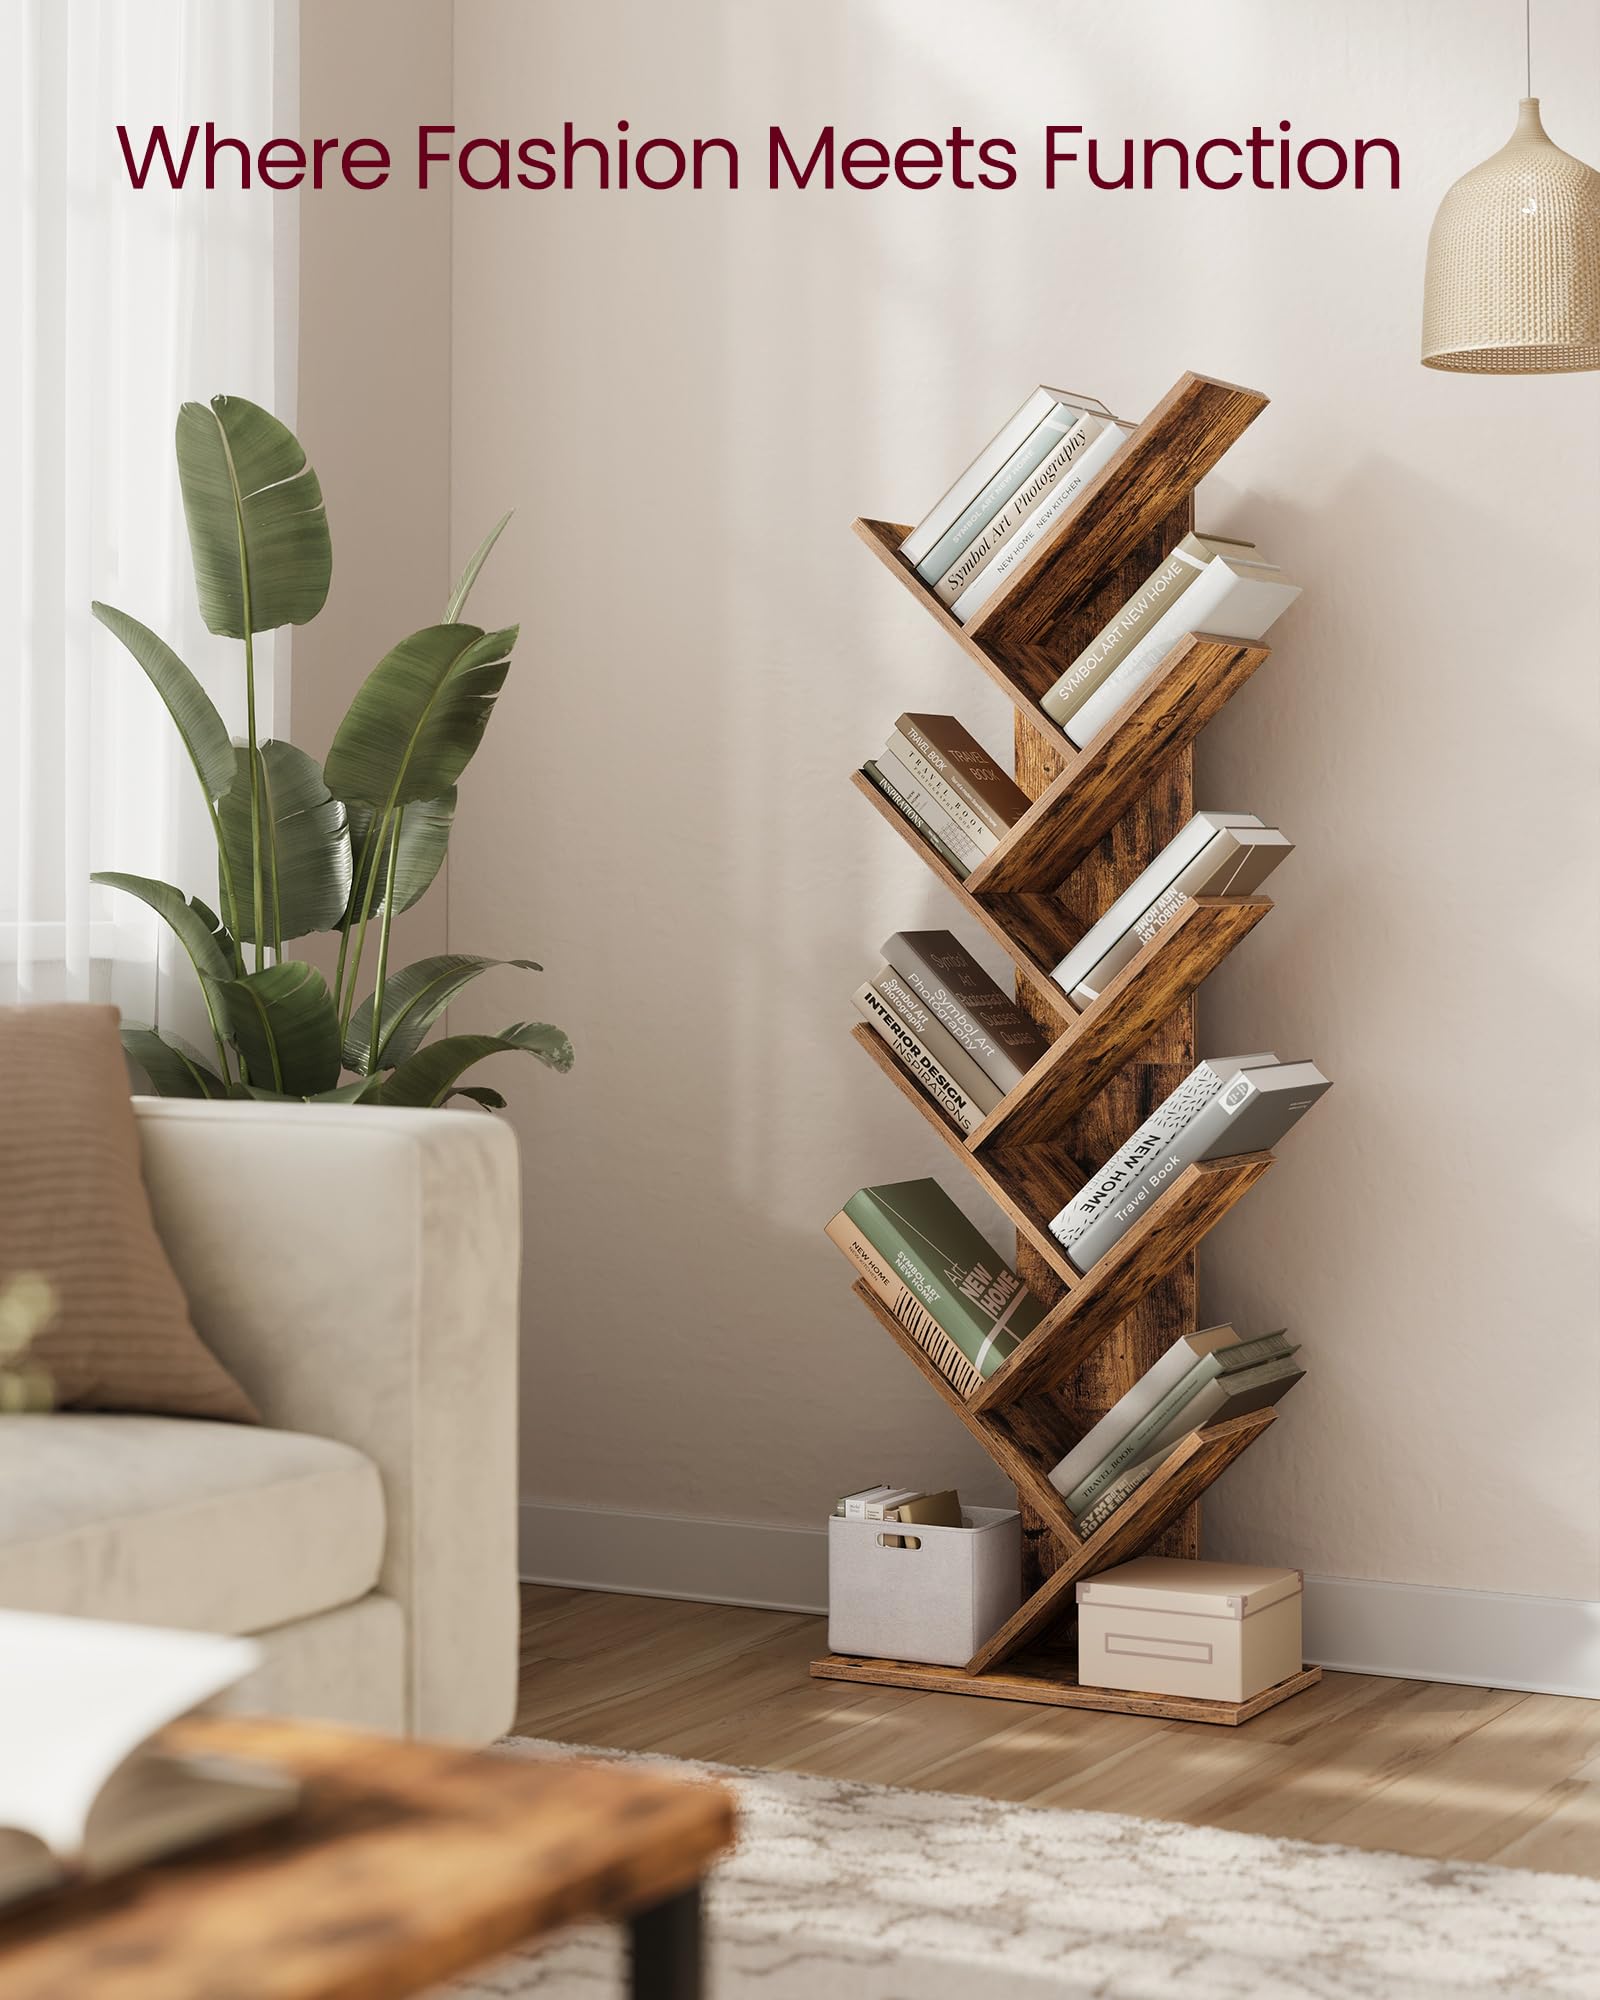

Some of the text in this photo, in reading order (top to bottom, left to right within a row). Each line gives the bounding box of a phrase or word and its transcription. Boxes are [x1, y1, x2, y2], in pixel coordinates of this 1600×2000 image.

[948, 429, 1088, 592] Symbol Art Photography
[952, 509, 983, 545] SYMBOL
[981, 491, 999, 513] ART
[994, 473, 1014, 497] NEW
[997, 476, 1082, 574] NEW HOME NEW KITCHEN
[1058, 653, 1104, 701] SYMBOL
[1101, 627, 1124, 655] ART
[1121, 597, 1150, 631] NEW
[1146, 561, 1183, 603] HOME
[907, 728, 948, 772] TRAVEL BOOK
[878, 778, 925, 829] INSPIRATIONS
[908, 751, 950, 796] TRAVEL
[954, 802, 984, 835] BOOK
[1133, 886, 1179, 936] NEW HOME
[1138, 891, 1188, 946] SYMBOL ART
[879, 981, 926, 1034] Photography
[888, 978, 930, 1025] Symbol Art
[908, 973, 979, 1052] Photography
[934, 988, 996, 1057] Symbol Art
[864, 992, 967, 1110] INTERIOR DESIGN
[892, 1038, 972, 1131] INSPIRATIONS
[1080, 1134, 1161, 1214] NEW HOME
[1113, 1155, 1181, 1222] Travel Book
[852, 1241, 891, 1287] NEW HOME
[895, 1258, 934, 1305] NEW HOME
[897, 1251, 941, 1301] SYMBOL ART
[943, 1262, 968, 1288] Art
[958, 1262, 993, 1300] NEW
[980, 1269, 1020, 1317] HOME
[1082, 1446, 1135, 1498] TRAVEL BOOK
[1080, 1500, 1118, 1539] HOME
